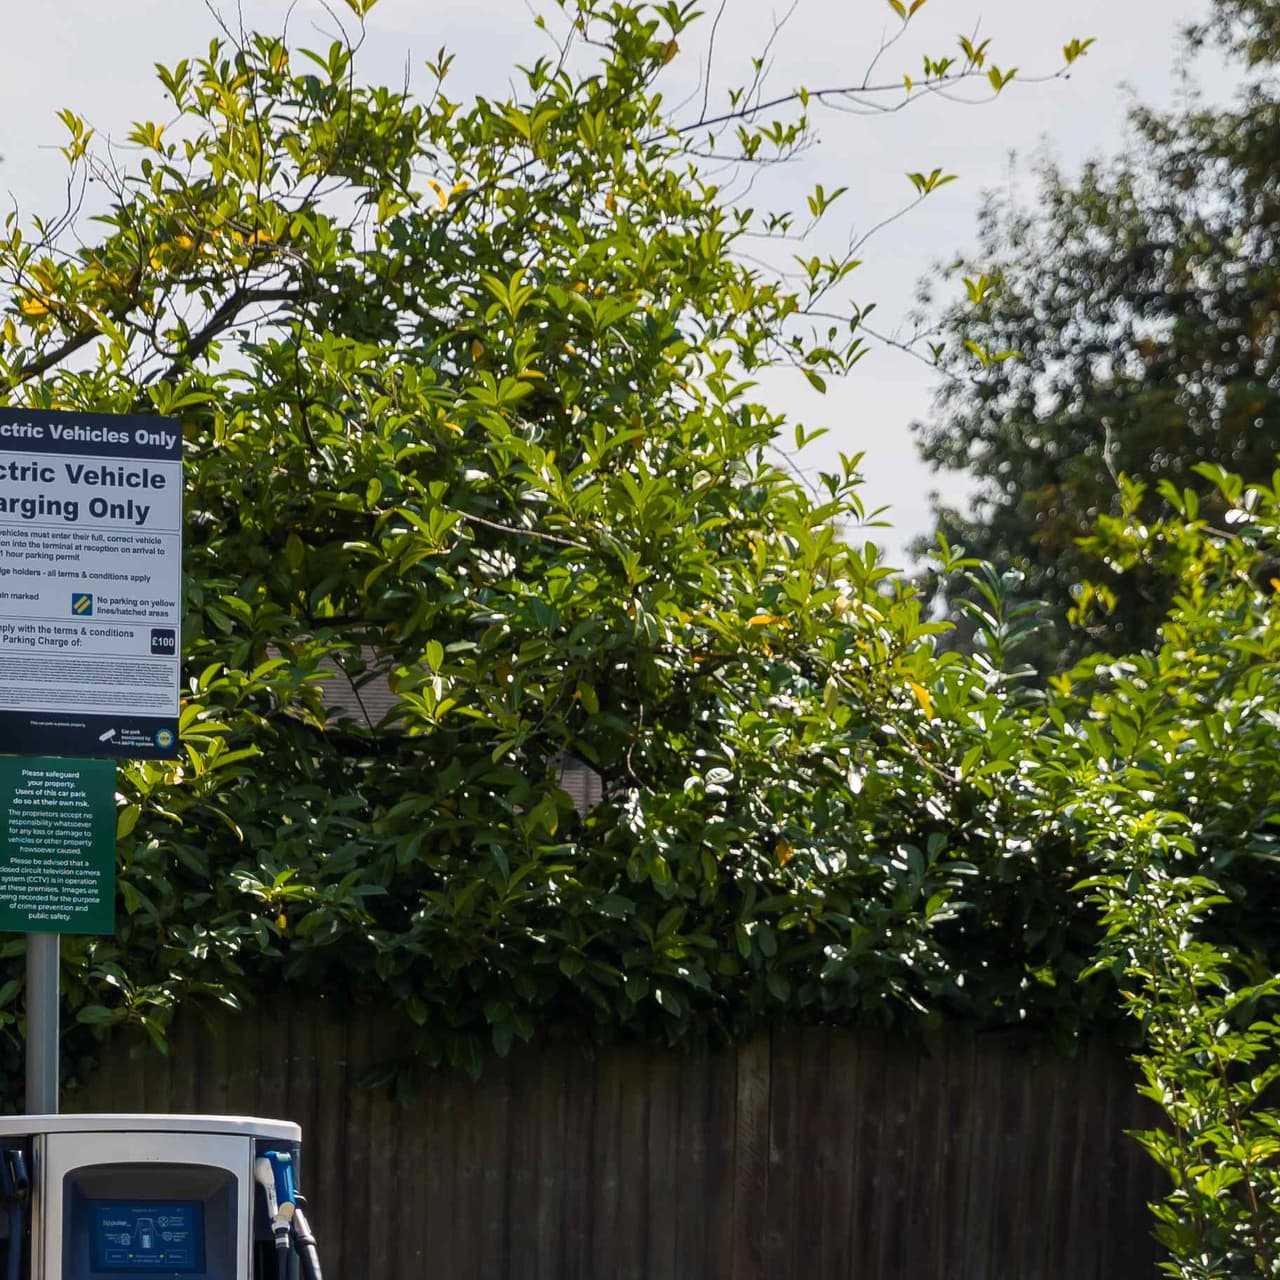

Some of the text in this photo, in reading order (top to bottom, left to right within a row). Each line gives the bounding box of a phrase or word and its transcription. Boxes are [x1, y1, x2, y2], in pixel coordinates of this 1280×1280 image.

[49, 424, 129, 444] Vehicles
[135, 430, 176, 449] Only
[65, 464, 166, 489] Vehicle
[89, 498, 150, 525] Only
[135, 537, 161, 545] vehicle
[29, 540, 40, 548] the
[42, 541, 73, 550] terminal
[84, 545, 118, 553] reception
[132, 547, 156, 555] arrival
[6, 550, 23, 558] hour
[25, 552, 53, 561] parking
[56, 553, 80, 561] permit
[12, 568, 40, 576] holders
[58, 570, 79, 578] terms
[81, 571, 87, 579] &
[89, 572, 128, 580] conditions
[130, 574, 150, 583] apply
[10, 592, 39, 600] marked
[97, 596, 107, 604] No
[110, 597, 137, 606] parking
[151, 599, 175, 608] yellow
[97, 606, 146, 616] lines/hatched
[18, 624, 35, 632] with
[38, 625, 51, 633] the
[54, 627, 78, 635] terms
[81, 627, 87, 635] &
[90, 628, 134, 637] conditions
[3, 635, 35, 646] Parking
[38, 636, 69, 647] Charge
[152, 637, 175, 646] £100
[46, 771, 80, 779] safeguard
[70, 790, 86, 798] park
[22, 810, 59, 818] proprietors
[8, 819, 52, 827] responsibility
[55, 829, 83, 837] damage
[64, 839, 92, 847] property
[62, 886, 86, 894] Images
[38, 904, 73, 912] prevention
